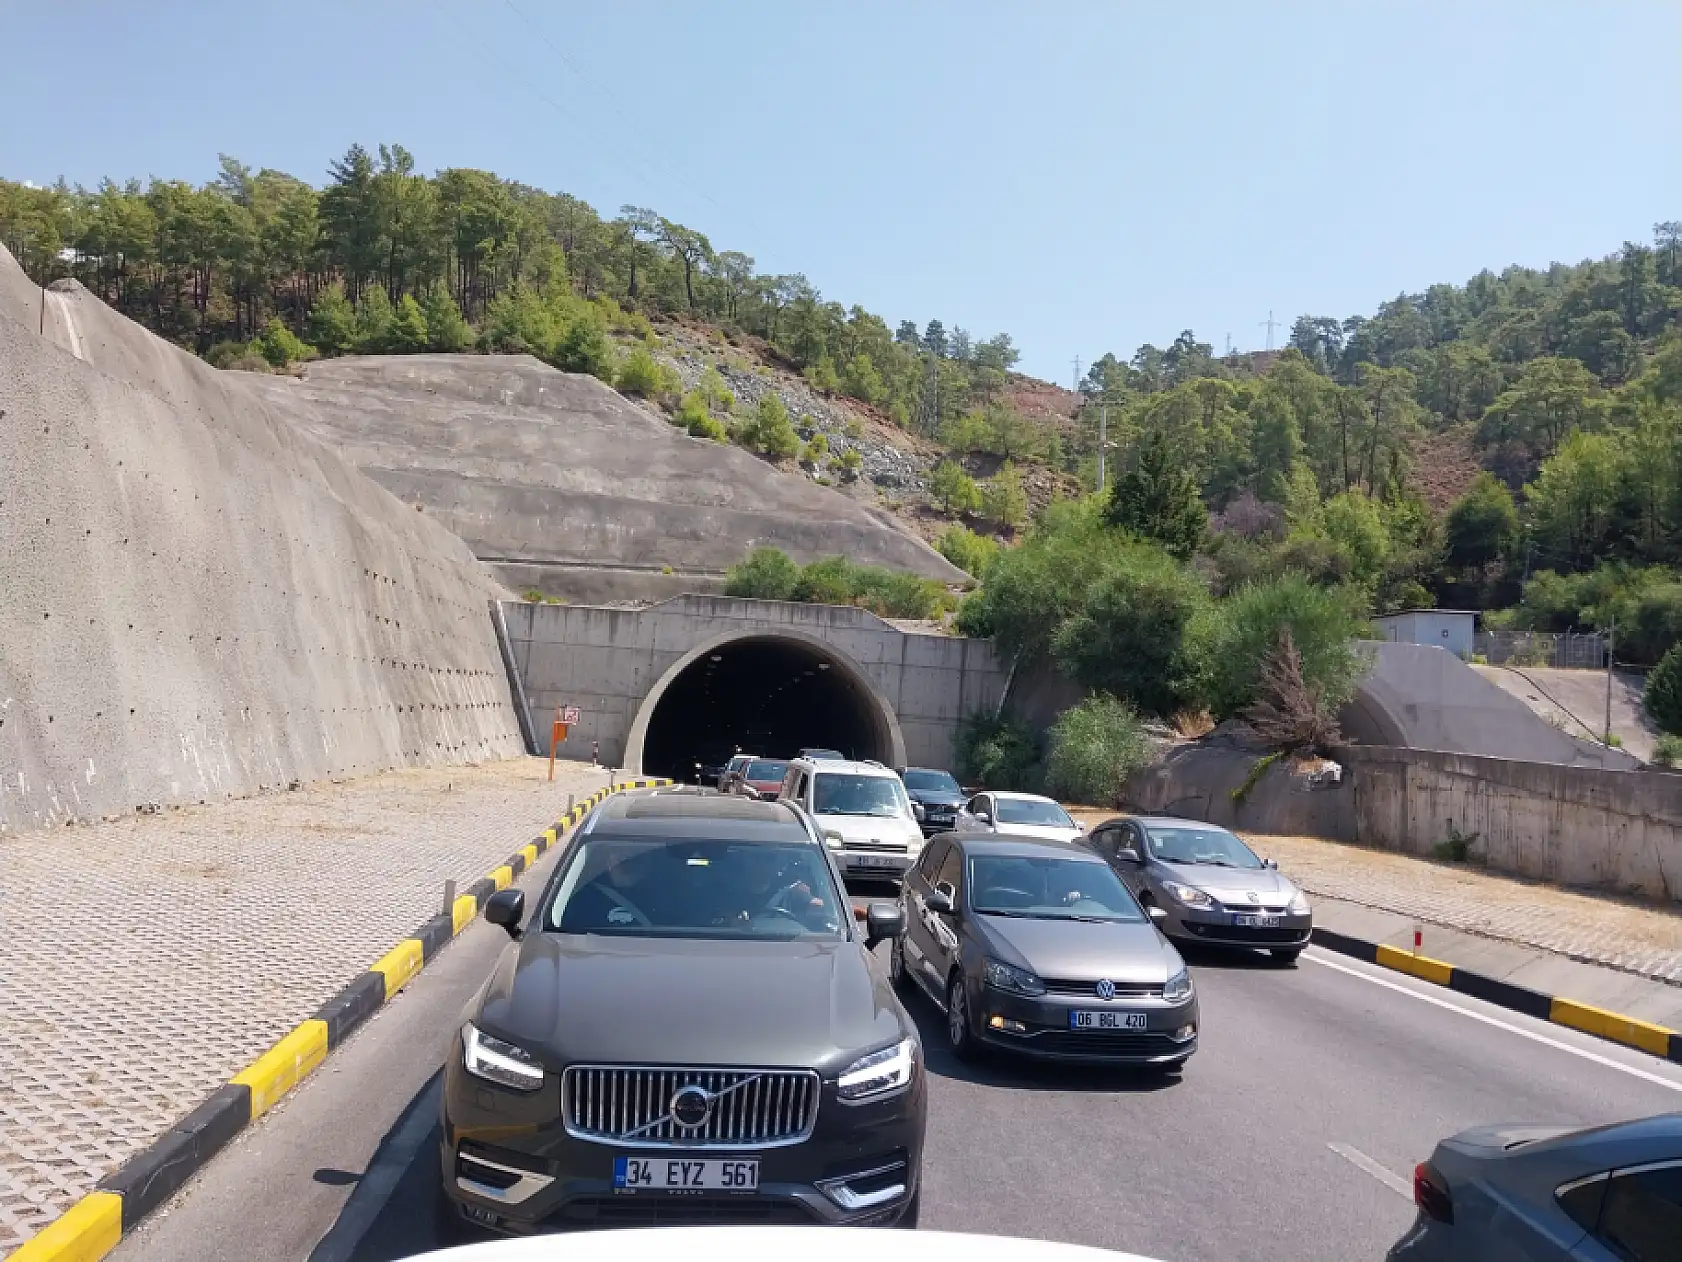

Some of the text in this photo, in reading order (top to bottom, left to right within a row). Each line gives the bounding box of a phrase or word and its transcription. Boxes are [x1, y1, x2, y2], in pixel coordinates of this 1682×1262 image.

[1078, 1013, 1092, 1026] 06
[1125, 1014, 1146, 1028] 420
[627, 1160, 757, 1187] 34 EYZ 561
